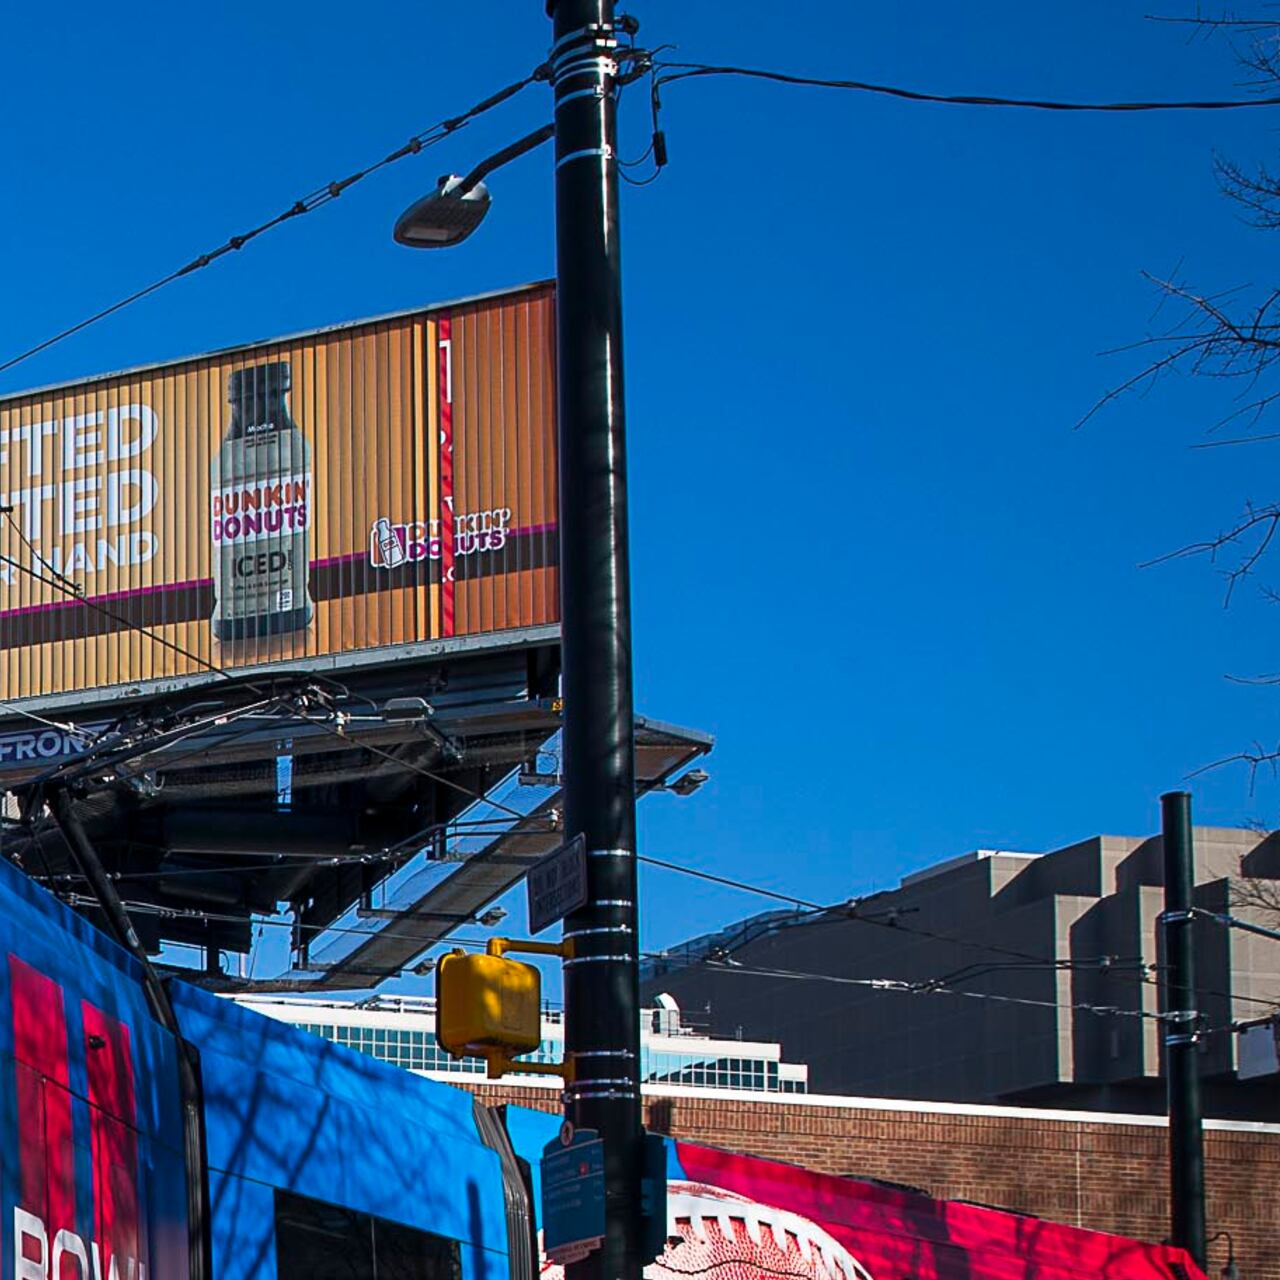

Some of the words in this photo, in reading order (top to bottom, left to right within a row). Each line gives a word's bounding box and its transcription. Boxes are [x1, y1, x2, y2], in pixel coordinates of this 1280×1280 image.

[213, 505, 307, 541] DONUTS
[33, 531, 159, 580] HAND
[232, 551, 286, 579] ICED
